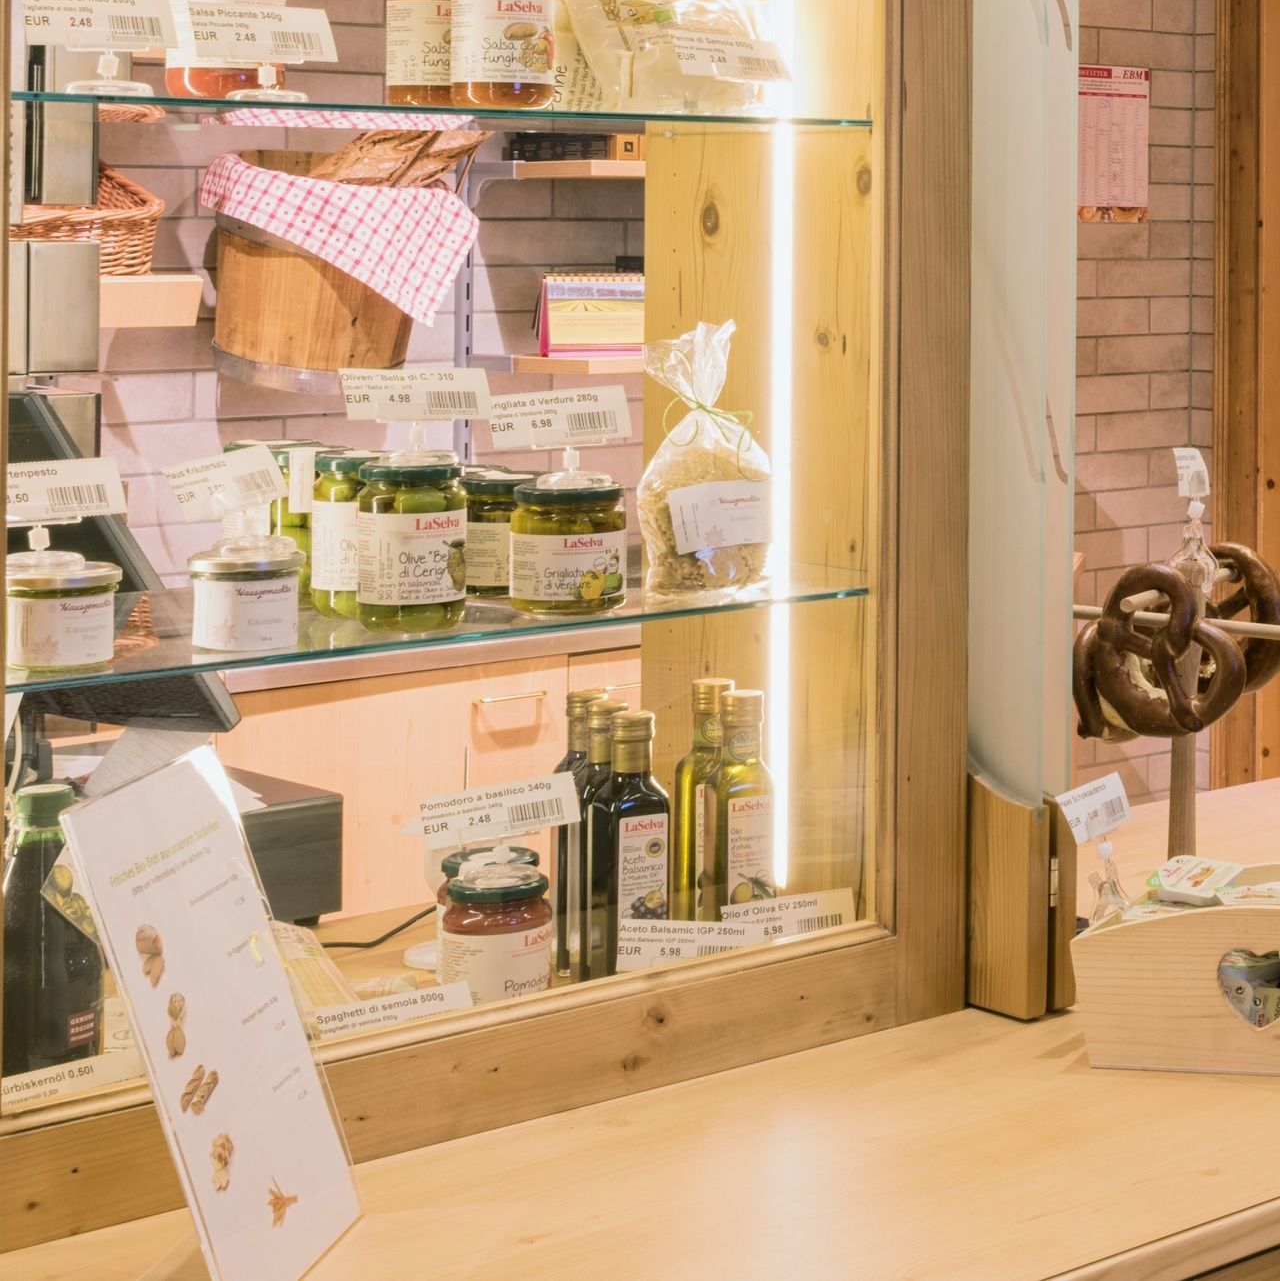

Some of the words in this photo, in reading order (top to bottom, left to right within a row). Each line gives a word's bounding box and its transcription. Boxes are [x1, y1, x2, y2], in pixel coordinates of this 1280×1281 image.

[496, 0, 543, 14] LaSelva
[25, 15, 50, 26] EUR
[70, 17, 93, 28] 2,48
[189, 7, 216, 17] Salsa
[217, 9, 258, 20] Piccante
[260, 11, 283, 22] 340g
[194, 31, 218, 41] EUR
[482, 37, 517, 51] Salsa
[520, 42, 539, 51] con
[482, 54, 521, 68] funghi
[677, 52, 697, 61] EUR
[1122, 69, 1144, 81] EBM
[341, 372, 373, 382] Oliven
[409, 372, 419, 381] di
[437, 372, 455, 381] 310
[346, 394, 370, 404] EUR
[388, 394, 411, 404] 4,98
[490, 399, 528, 411] rigliata
[538, 396, 574, 408] Verdure
[577, 393, 598, 404] 280g
[491, 423, 515, 433] EUR
[531, 418, 553, 429] 6,98
[177, 491, 197, 503] EUR
[415, 516, 460, 531] LaSelva
[563, 537, 603, 549] LaSelva
[398, 552, 427, 564] Olive
[398, 567, 410, 579] di
[544, 567, 585, 582] Grigliata
[544, 580, 551, 590] di
[555, 579, 592, 591] verdure
[420, 796, 474, 812] Pomodoro
[485, 786, 525, 800] basilico
[527, 782, 552, 792] 340g
[424, 822, 449, 835] EUR
[468, 813, 492, 826] 2,48
[624, 819, 665, 833] LaSelva
[623, 856, 646, 865] Aceto
[622, 861, 664, 875] Balsamico
[721, 910, 741, 920] Olio
[753, 906, 776, 916] Oliva
[778, 903, 790, 911] EV
[792, 899, 818, 910] 250ml
[524, 927, 551, 948] LaSel
[619, 925, 648, 933] Aceto
[650, 925, 694, 934] Balsamic
[697, 927, 714, 935] IGP
[717, 928, 746, 936] 250ml
[618, 946, 642, 956] EUR
[660, 948, 681, 957] 5,98
[504, 972, 549, 992] Pomodor
[316, 1005, 366, 1025] Spaghetti
[369, 1003, 379, 1014] di
[381, 996, 418, 1011] semola
[420, 991, 445, 1005] 500g
[2, 1072, 66, 1096] ürbiskernöl
